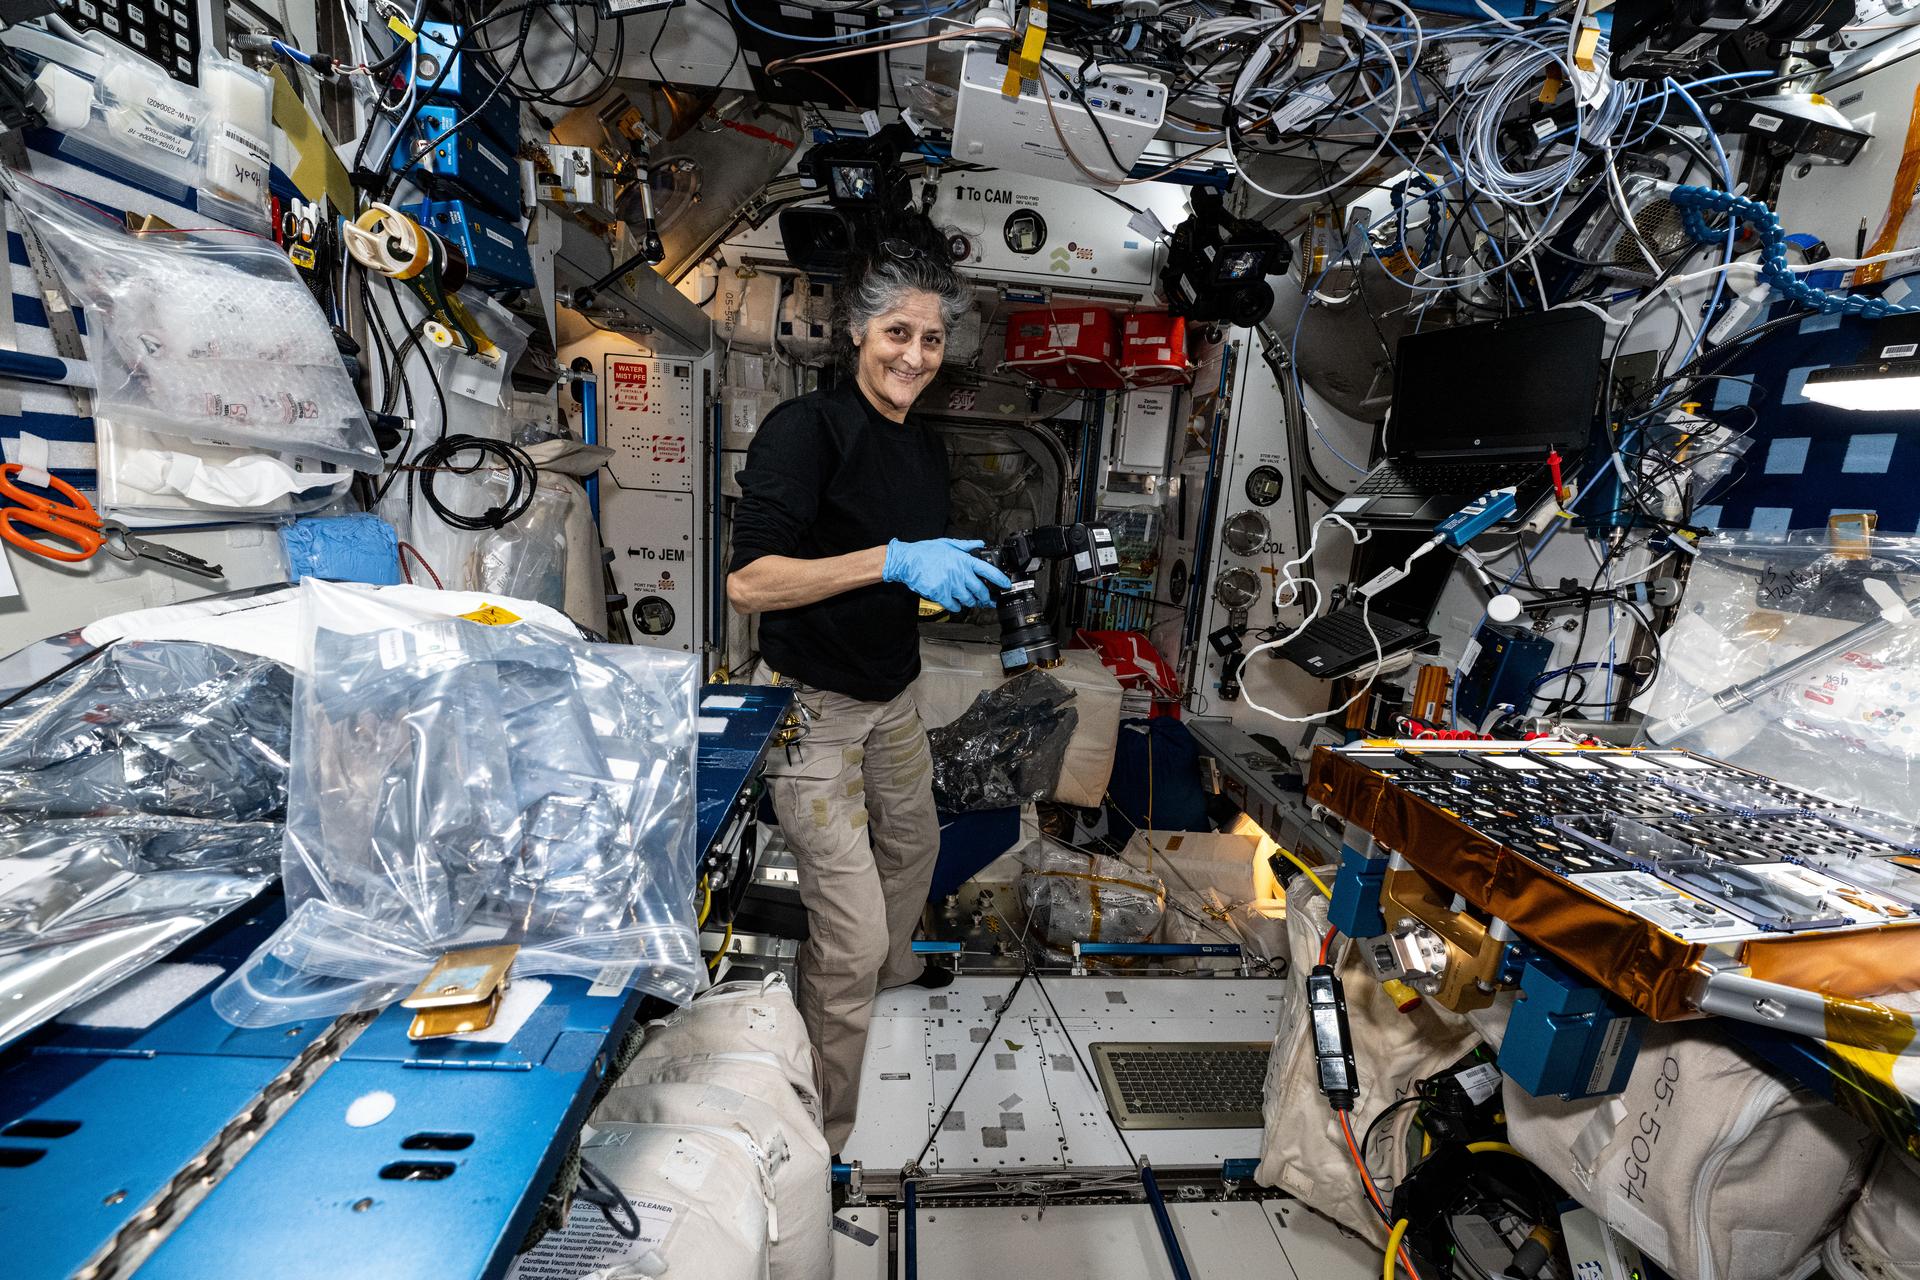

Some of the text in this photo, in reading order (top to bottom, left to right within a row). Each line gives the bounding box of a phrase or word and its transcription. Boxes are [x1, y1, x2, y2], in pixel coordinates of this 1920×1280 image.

[144, 126, 159, 137] Hook
[967, 187, 1013, 205] To CAM
[633, 373, 646, 381] PFE
[1262, 542, 1286, 555] COL
[640, 548, 685, 562] To JEM
[637, 1201, 673, 1214] CLEANER
[570, 1215, 589, 1223] Makita
[571, 1223, 595, 1231] Vacuum
[567, 1230, 592, 1238] Vacuum
[591, 1231, 616, 1239] Cleaner
[563, 1236, 585, 1244] Vacuum
[585, 1238, 611, 1246] Cleaner
[611, 1240, 624, 1249] Bag
[559, 1244, 584, 1252] Vacuum
[584, 1245, 602, 1253] HEPA
[526, 1250, 555, 1258] Cordless
[551, 1259, 575, 1267] Vacuum
[575, 1260, 593, 1268] Hose
[518, 1265, 537, 1273] Makita
[536, 1266, 561, 1275] Battery
[561, 1267, 578, 1276] Pack
